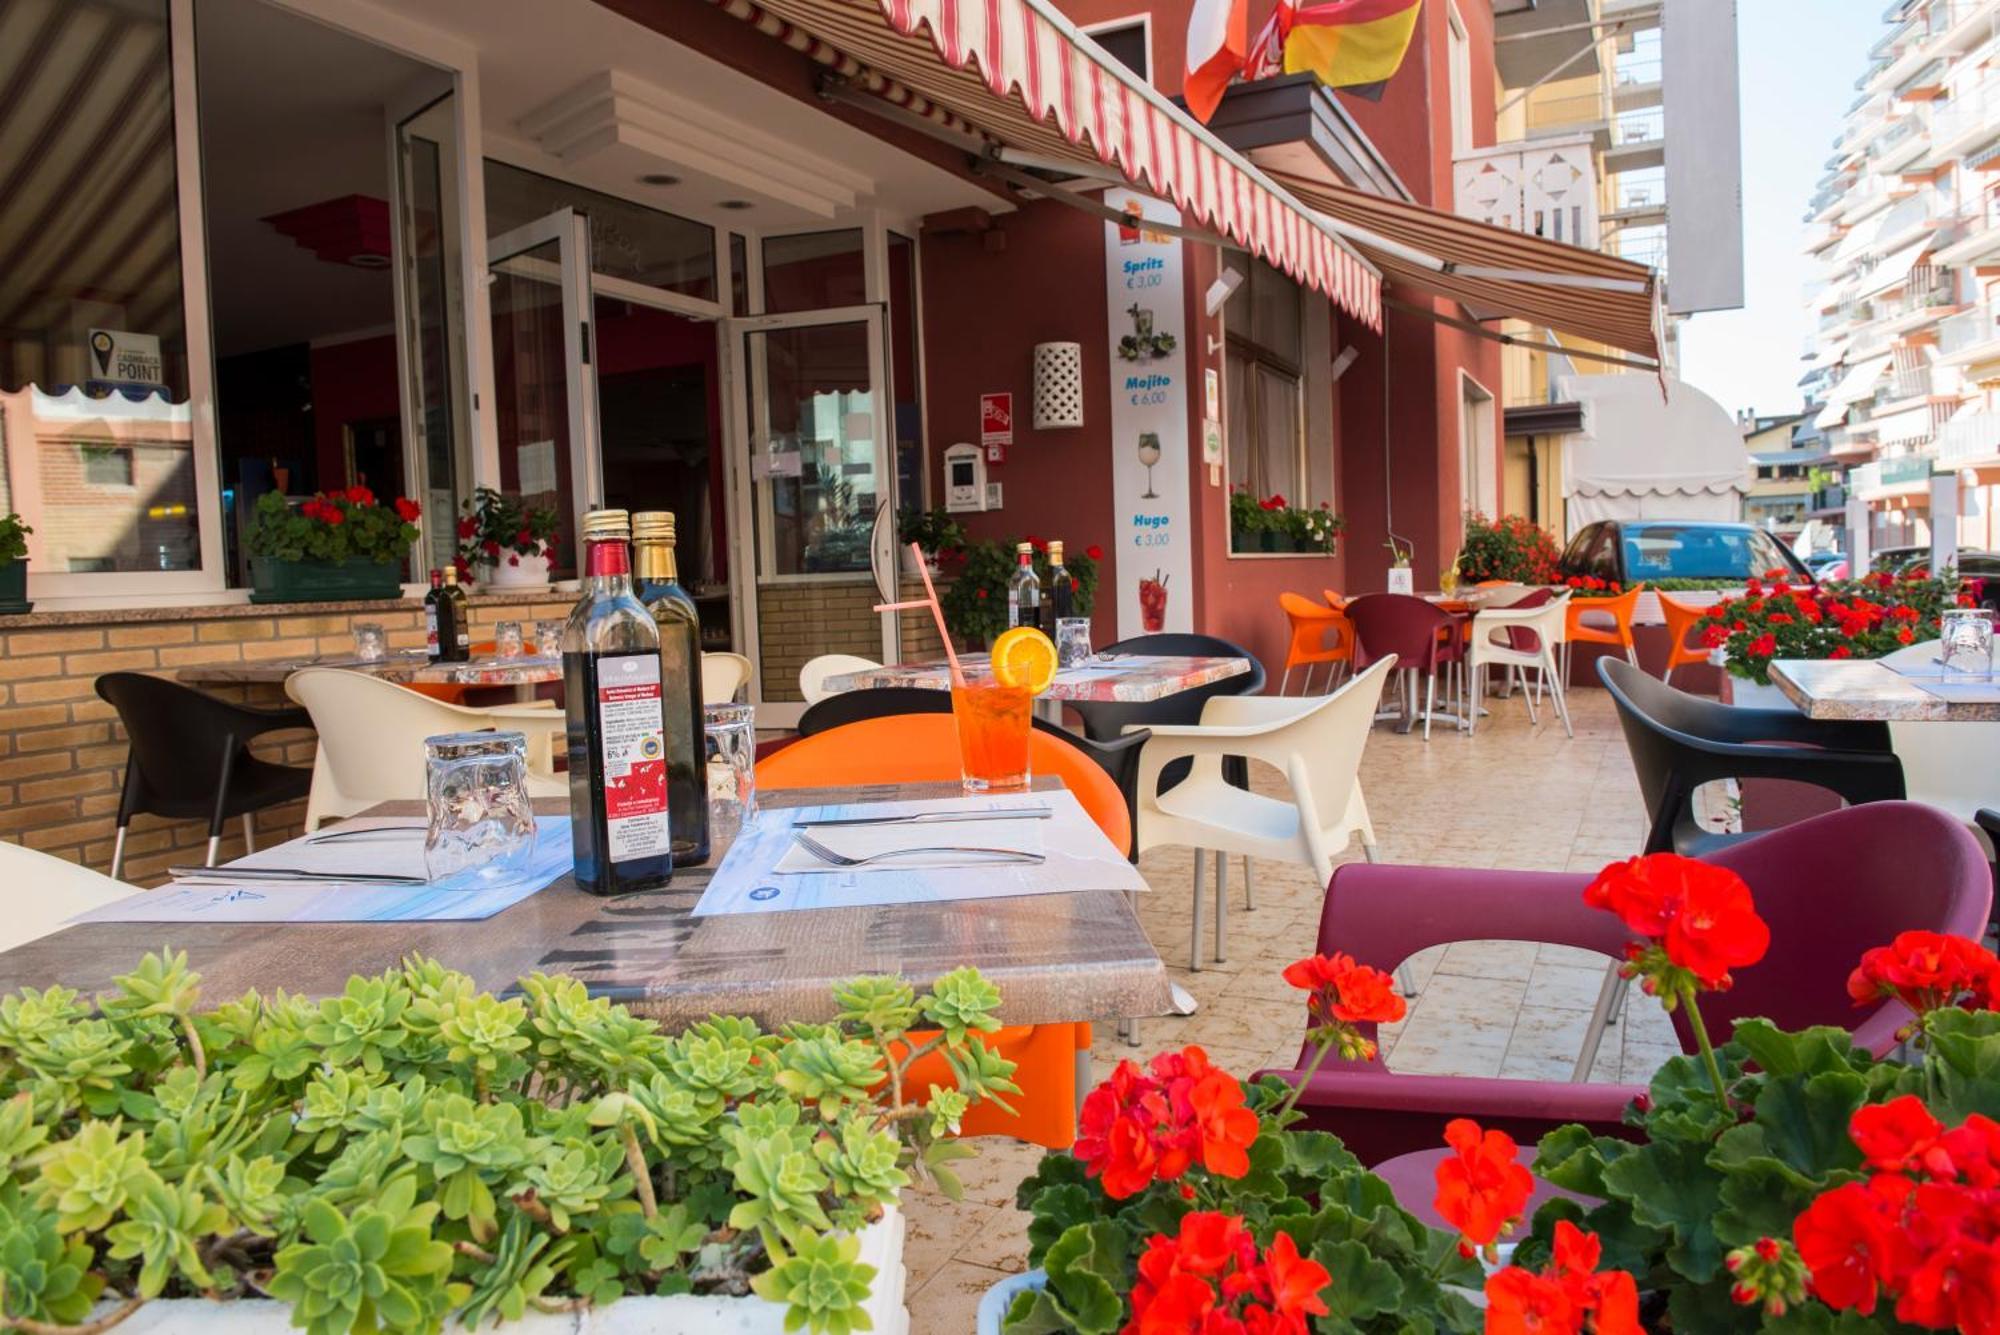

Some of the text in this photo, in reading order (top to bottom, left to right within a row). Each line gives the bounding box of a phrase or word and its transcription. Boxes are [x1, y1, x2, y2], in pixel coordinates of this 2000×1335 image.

[1123, 257, 1164, 276] Spritz
[1127, 277, 1135, 289] €
[118, 362, 161, 381] POINT
[1125, 374, 1170, 391] Mojito
[1131, 394, 1139, 406] €
[1133, 514, 1169, 529] Hugo
[1135, 535, 1142, 546] €
